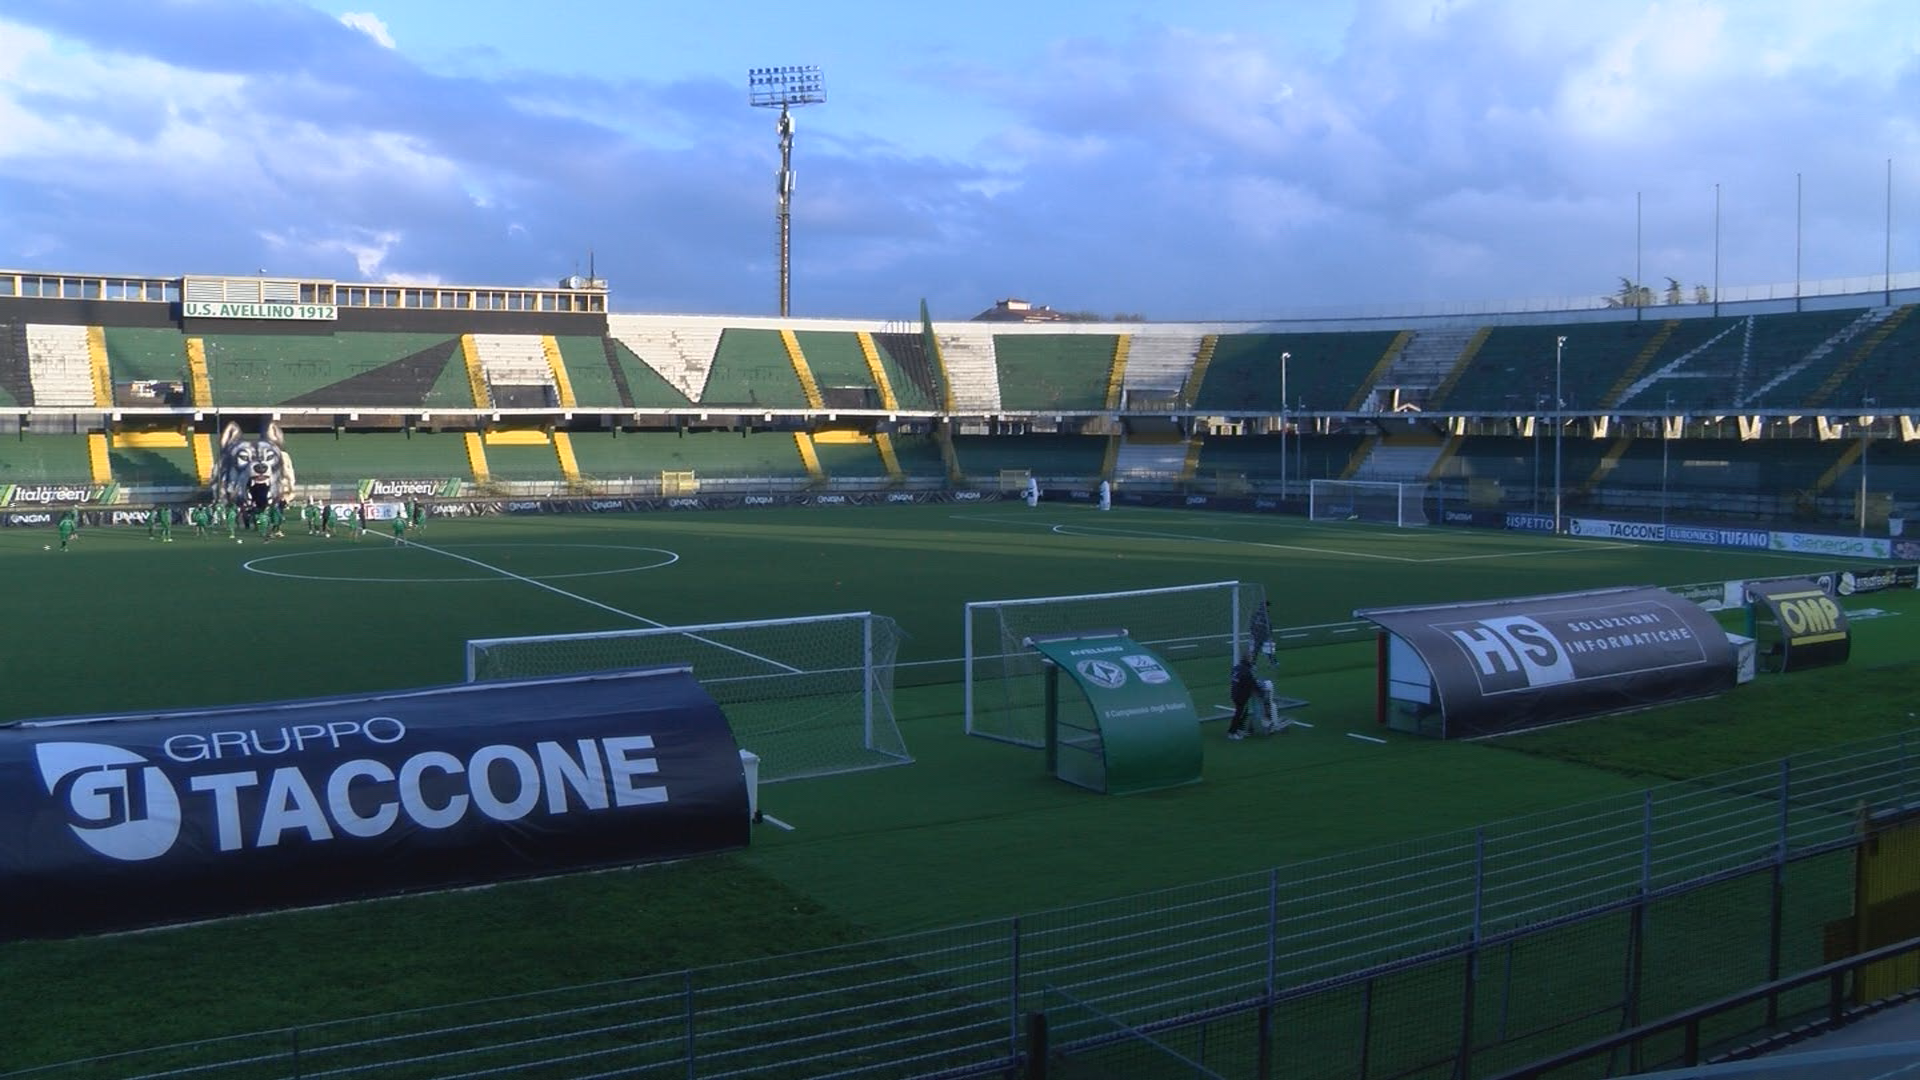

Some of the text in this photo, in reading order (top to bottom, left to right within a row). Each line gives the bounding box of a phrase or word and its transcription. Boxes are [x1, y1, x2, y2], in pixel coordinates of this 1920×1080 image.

[186, 303, 334, 319] U.S. AVELLINO 1912
[1609, 523, 1664, 540] TACCONE
[1669, 528, 1767, 547] EURONICS TUFANO
[1567, 613, 1661, 632] SOLUZIONI
[1779, 597, 1840, 634] OMP
[1452, 623, 1559, 675] HS
[1565, 628, 1692, 654] INFORMATICHE
[163, 717, 406, 762] GRUPPO
[192, 734, 669, 852] TACCONE
